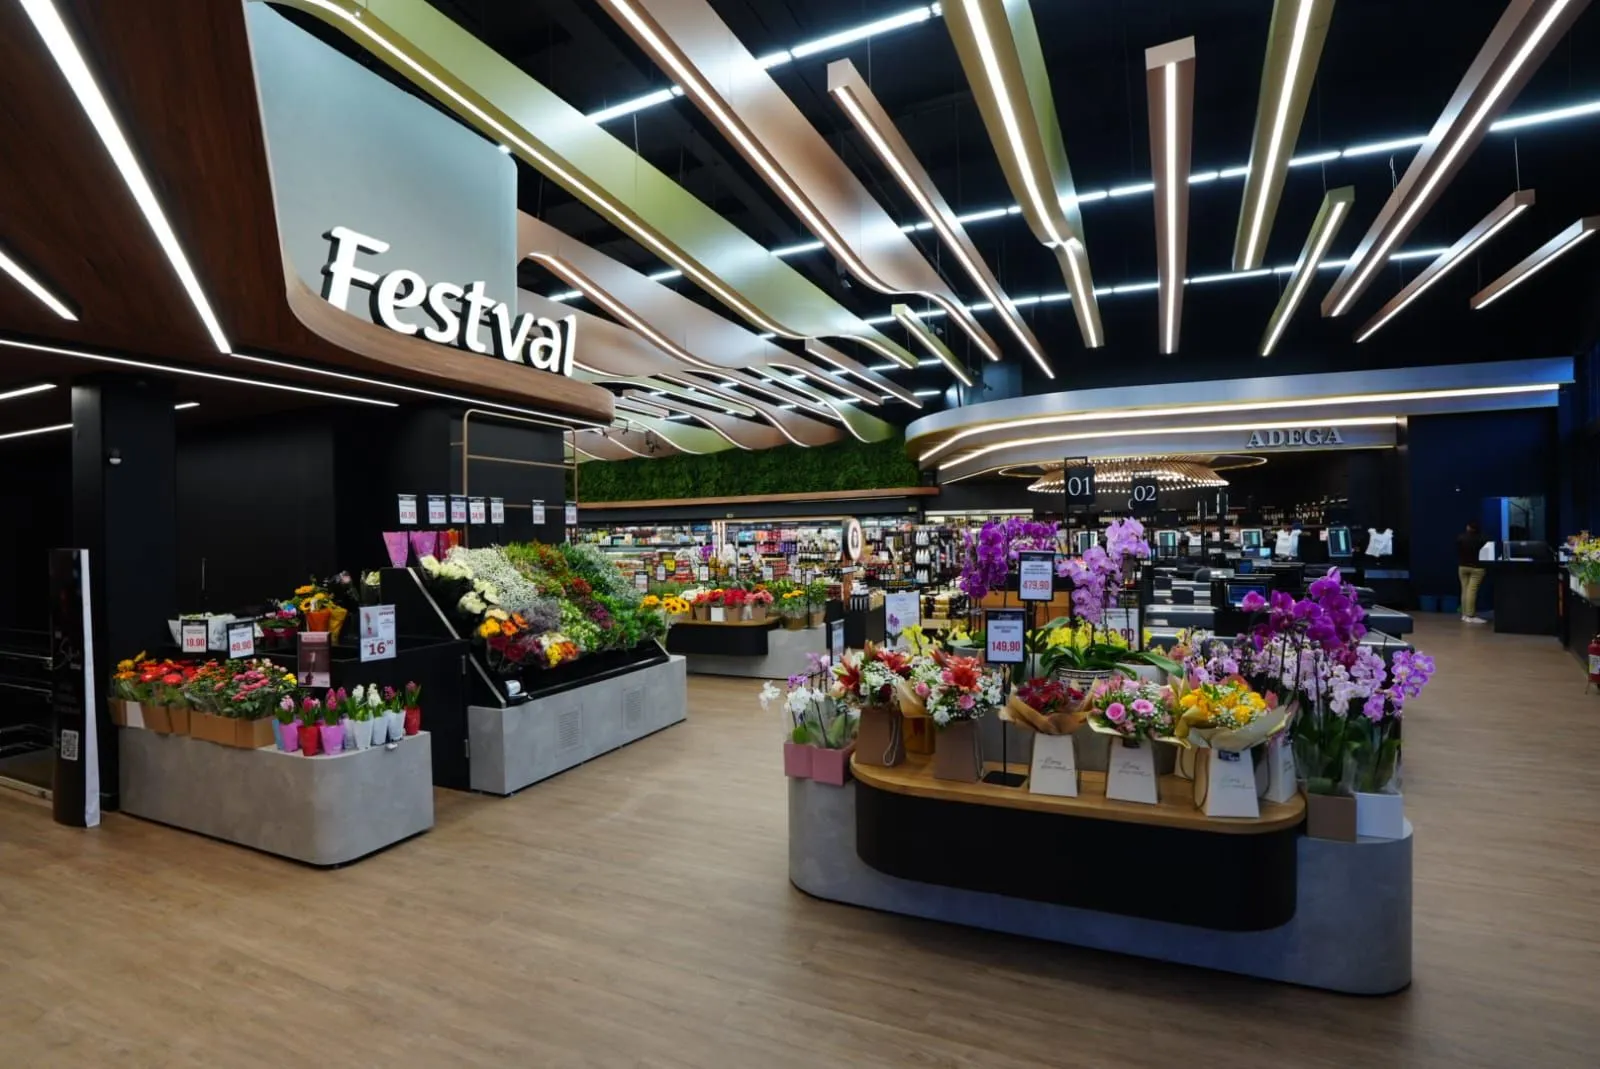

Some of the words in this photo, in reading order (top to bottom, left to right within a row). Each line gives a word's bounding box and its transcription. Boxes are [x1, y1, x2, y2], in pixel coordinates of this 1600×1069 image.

[321, 226, 577, 377] Festval
[1246, 427, 1345, 448] ADEGA
[1068, 476, 1092, 496] 01
[1134, 485, 1156, 502] 02
